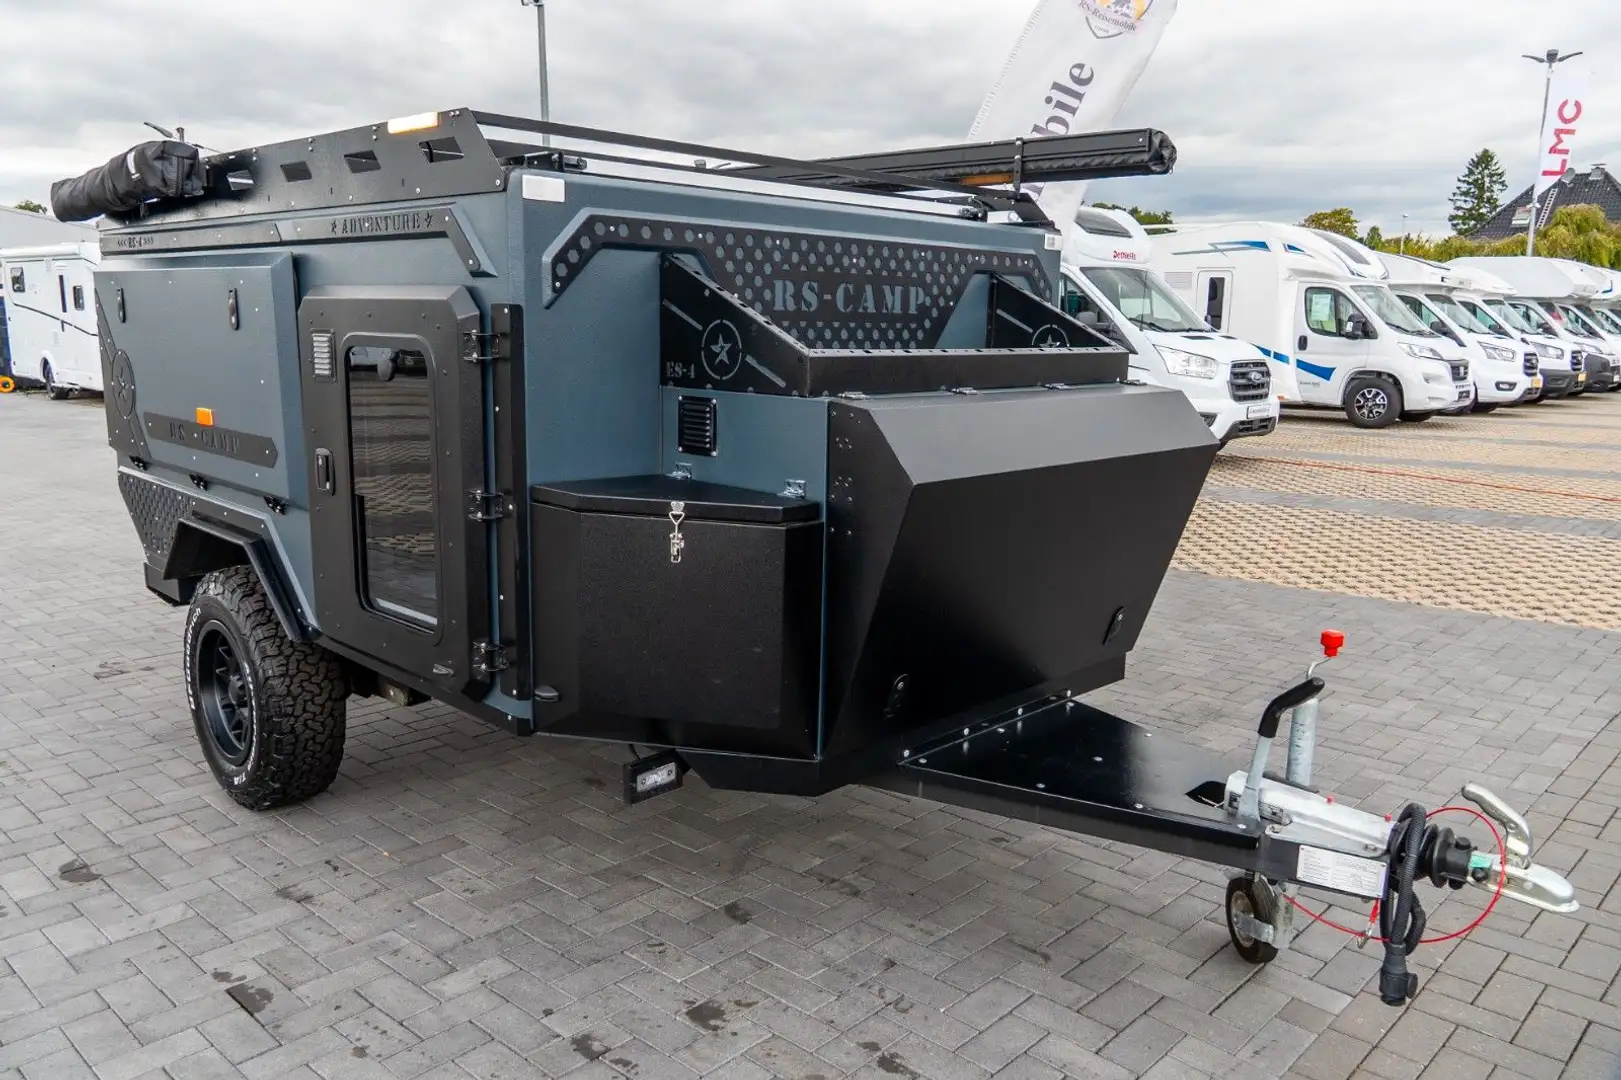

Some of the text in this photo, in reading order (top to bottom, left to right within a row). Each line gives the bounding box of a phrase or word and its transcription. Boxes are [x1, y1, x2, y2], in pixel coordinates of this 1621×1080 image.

[1541, 99, 1582, 176] LMC
[341, 213, 421, 234] ADVENTURE
[773, 279, 925, 315] RS-CAMP
